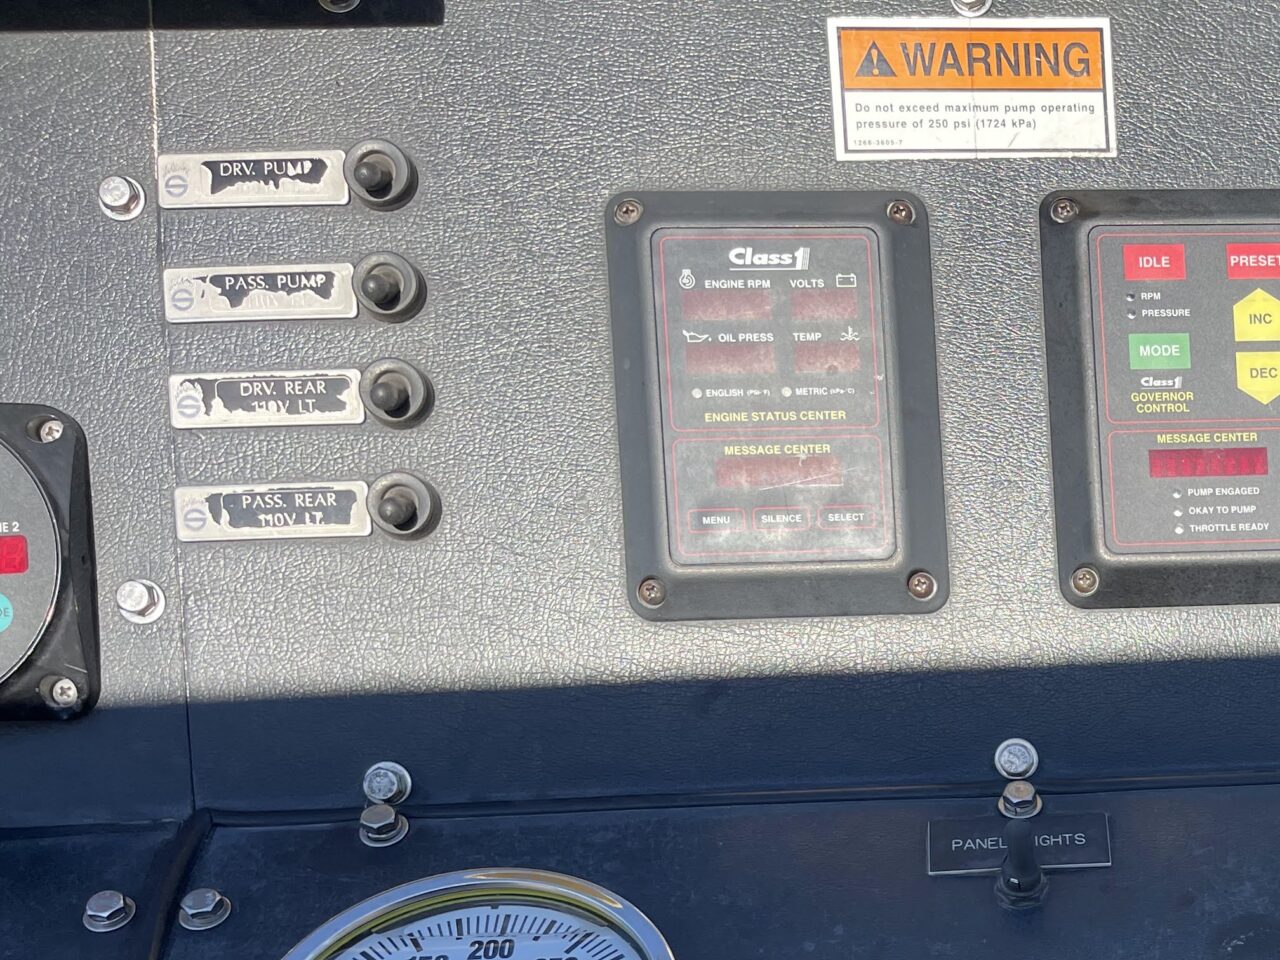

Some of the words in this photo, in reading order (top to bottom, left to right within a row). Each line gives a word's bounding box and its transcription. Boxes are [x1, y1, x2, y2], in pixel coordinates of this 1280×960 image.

[900, 42, 1091, 77] WARNING
[855, 103, 870, 113] Do
[875, 103, 894, 113] not
[899, 102, 939, 113] exceed
[945, 103, 999, 113] maximum
[1004, 104, 1036, 115] pump
[1041, 103, 1095, 115] operating
[856, 119, 907, 130] pressure
[913, 119, 924, 129] of
[928, 119, 948, 129] 250
[954, 118, 971, 130] psi
[976, 118, 1007, 130] (1724
[1012, 118, 1037, 130] kPa)
[219, 162, 255, 176] DRV.
[264, 161, 313, 176] PUMP
[1139, 257, 1170, 268] IDLE
[225, 276, 269, 290] PASS.
[277, 275, 326, 288] PUMP
[705, 280, 745, 288] ENGINE
[747, 279, 770, 288] RPM
[789, 279, 825, 288] VOLTS
[1141, 292, 1161, 300] RPM
[1142, 309, 1191, 317] PRESSURE
[1249, 314, 1272, 325] INC
[718, 334, 736, 342] OIL
[738, 333, 774, 342] PRESS
[793, 333, 822, 341] TEMP
[1139, 345, 1181, 357] MODE
[1250, 367, 1278, 379] DEC
[240, 382, 276, 396] DRV.
[285, 381, 326, 394] REAR
[706, 389, 743, 397] ENGLISH
[795, 387, 828, 396] METRIC
[1131, 391, 1194, 402] GOVERNOR
[1136, 403, 1190, 414] CONTROL
[704, 412, 749, 422] ENGINE
[752, 411, 798, 421] STATUS
[800, 411, 846, 420] CENTER
[1157, 433, 1211, 444] MESSAGE
[1213, 432, 1258, 442] CENTER
[724, 445, 781, 455] MESSAGE
[784, 444, 831, 454] CENTER
[1188, 488, 1213, 497] PUMP
[1215, 487, 1260, 496] ENGAGED
[242, 495, 287, 509] PASS.
[295, 493, 337, 507] REAR
[1189, 506, 1214, 515] OKAY
[1216, 506, 1229, 514] TO
[1231, 505, 1257, 514] PUMP
[702, 516, 730, 525] MENU
[761, 514, 802, 523] SILENCE
[828, 513, 865, 521] SELECT
[1190, 524, 1237, 532] THROTTLE
[1239, 523, 1269, 532] READY
[952, 837, 1008, 851] PANEL
[467, 939, 515, 960] 200
